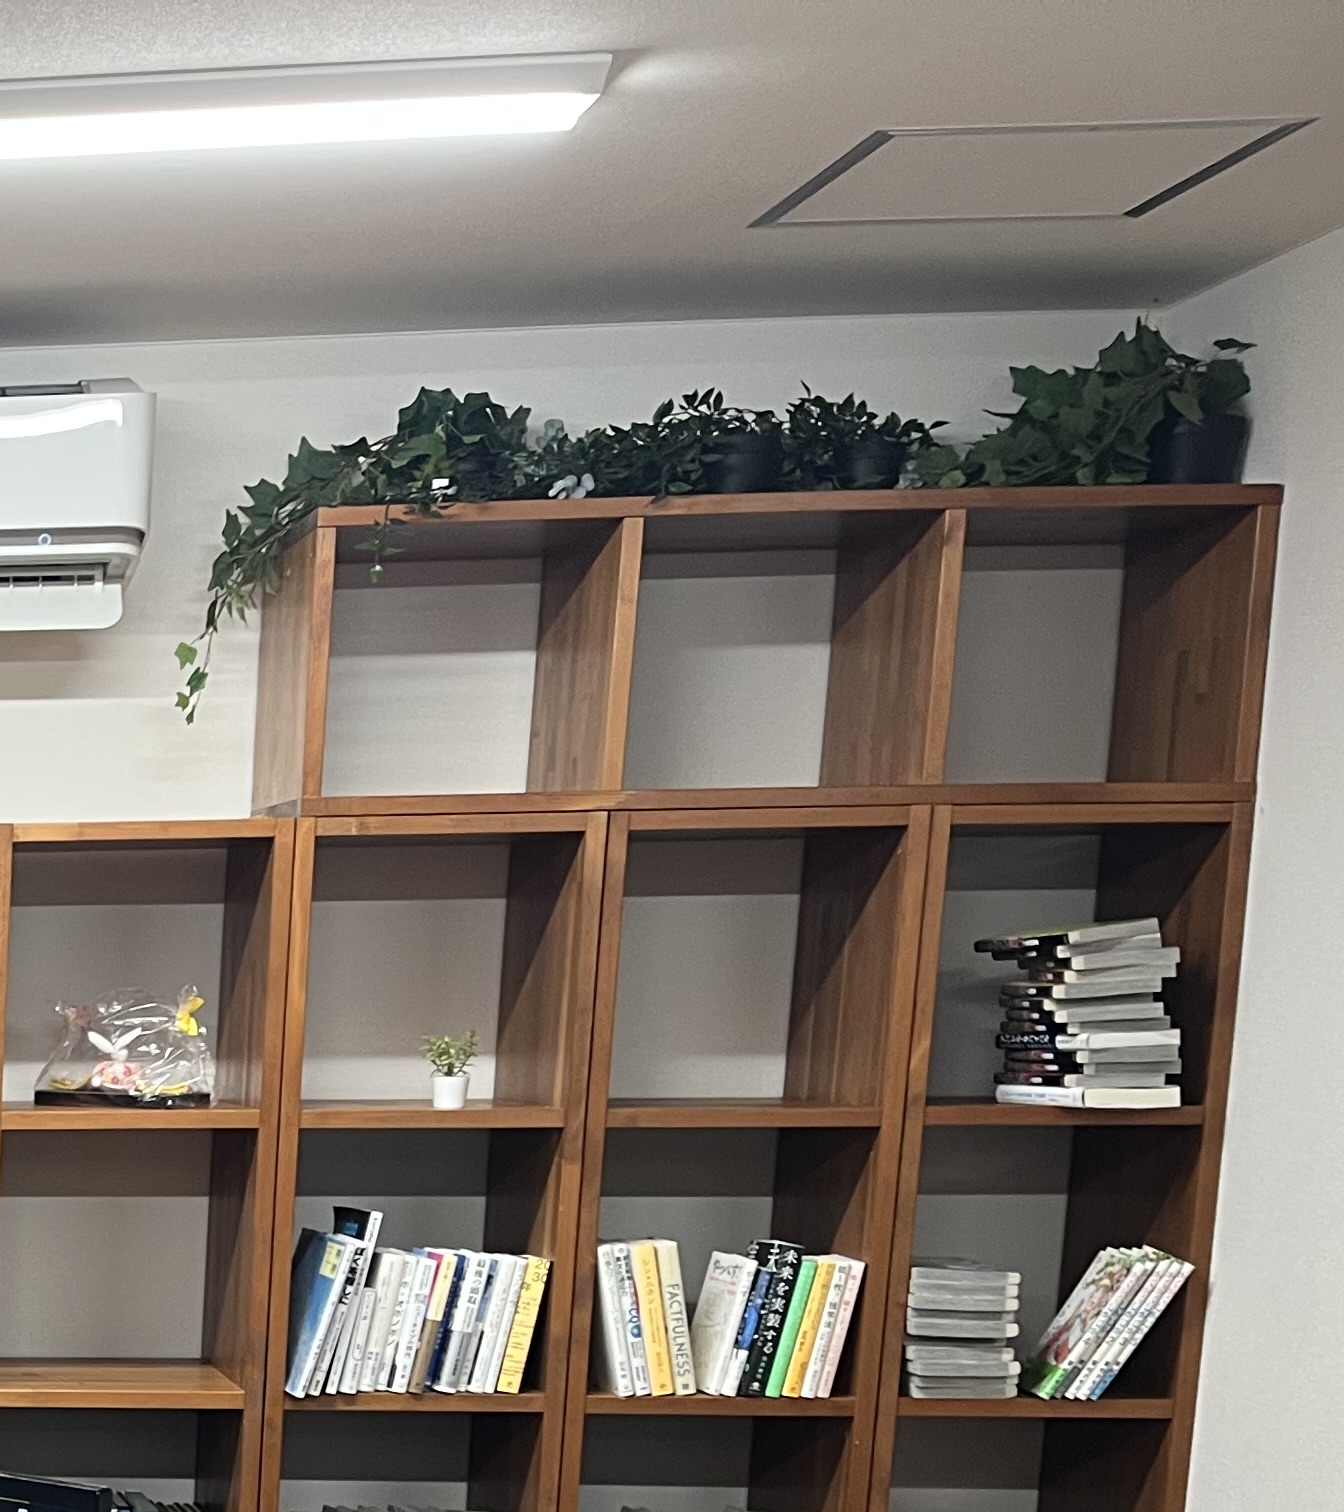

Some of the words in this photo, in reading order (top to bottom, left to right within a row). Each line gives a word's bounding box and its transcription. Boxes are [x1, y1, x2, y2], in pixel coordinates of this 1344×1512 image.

[666, 1283, 691, 1378] FACTFULNESS
[762, 1249, 799, 1354] 未来を実装する
